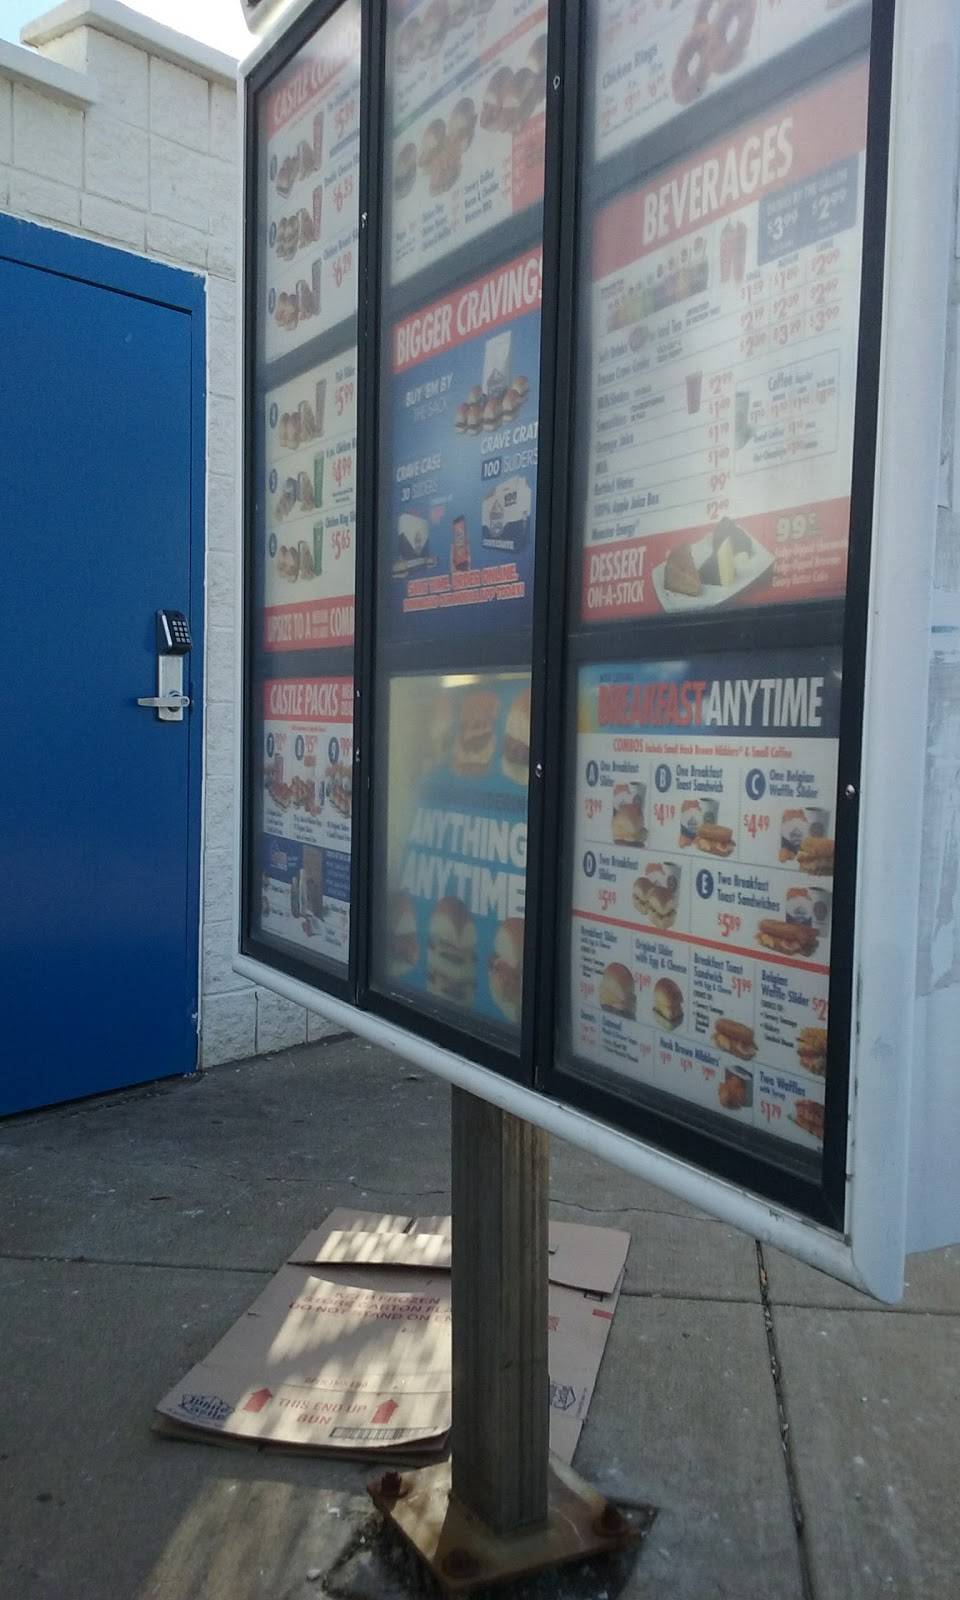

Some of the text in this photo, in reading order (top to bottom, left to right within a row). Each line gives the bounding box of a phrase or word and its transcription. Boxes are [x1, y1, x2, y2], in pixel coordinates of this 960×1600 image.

[643, 118, 793, 245] BEVERAGES
[396, 304, 452, 366] BIGGER
[406, 390, 422, 408] BUY
[439, 373, 454, 393] BY
[481, 429, 511, 455] CRAVE
[483, 458, 500, 478] 100
[590, 547, 646, 584] DESSERT
[587, 580, 644, 609] ON-A-STICK
[294, 614, 305, 640] TO
[305, 613, 313, 638] A
[270, 682, 302, 716] CASTLE
[304, 682, 338, 717] PACKS
[705, 676, 825, 728] ANYTIME
[613, 737, 644, 753] COMBOS
[676, 764, 724, 779] One Breakfast
[769, 769, 815, 784] One Belgian
[676, 778, 723, 793] Toast Sandwich
[769, 784, 818, 799] Waffle Slider
[411, 807, 527, 868] ANYTHING
[401, 852, 526, 921] ANYTIME
[718, 871, 769, 892] Two Breakfast
[717, 887, 780, 913] Toast Sandwiches
[694, 952, 744, 976] Breakfast Toast
[694, 966, 723, 984] Sandwich
[762, 970, 788, 987] Belgian
[761, 982, 809, 1007] Waffle Slider
[760, 1071, 806, 1097] Two Waffles
[405, 1312, 431, 1321] ON
[278, 1397, 368, 1412] THIS END UP
